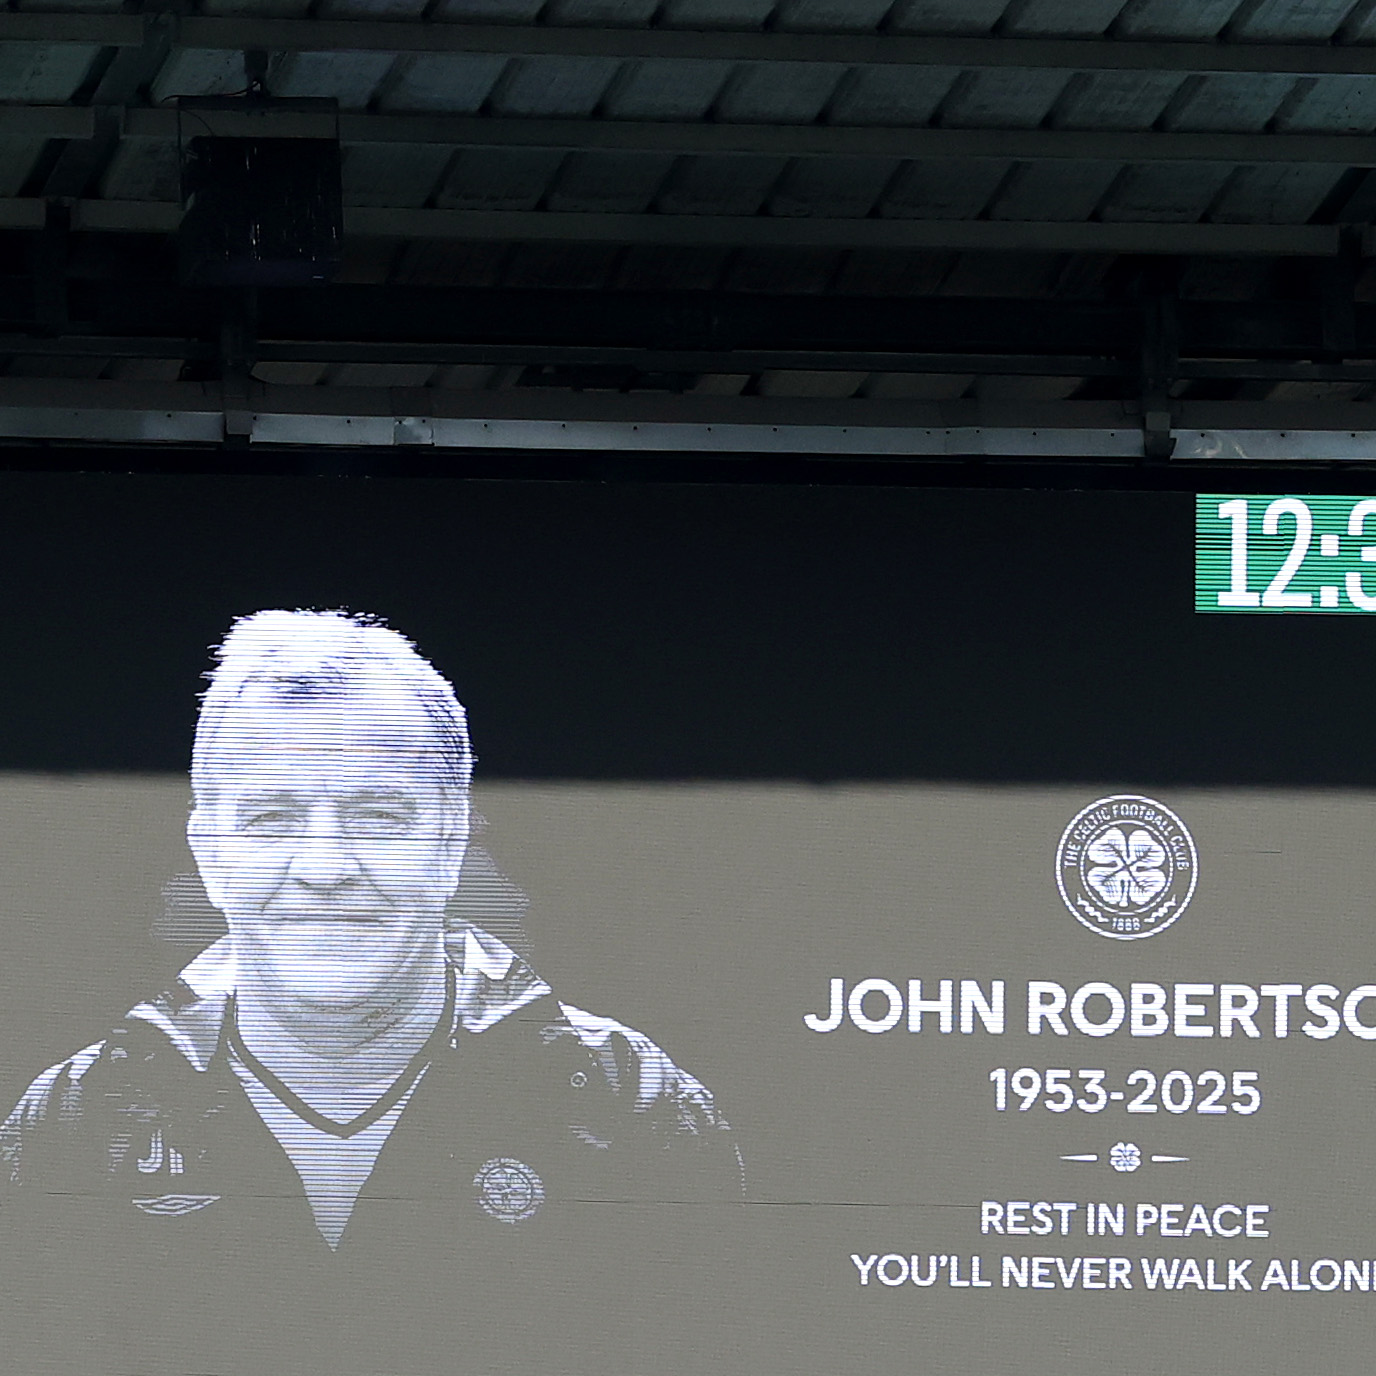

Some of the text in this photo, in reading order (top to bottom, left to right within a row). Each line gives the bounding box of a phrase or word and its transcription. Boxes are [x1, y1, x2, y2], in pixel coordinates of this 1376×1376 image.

[1064, 803, 1190, 871] THE CELTIC FOOTBALL CLUB
[803, 977, 1005, 1034] JOHN
[989, 1068, 1261, 1114] 1953-2025
[981, 1202, 1270, 1237] REST IN PEACE
[850, 1254, 992, 1287] YOU'LL
[1002, 1257, 1133, 1290] NEVER
[1140, 1258, 1253, 1291] WALK
